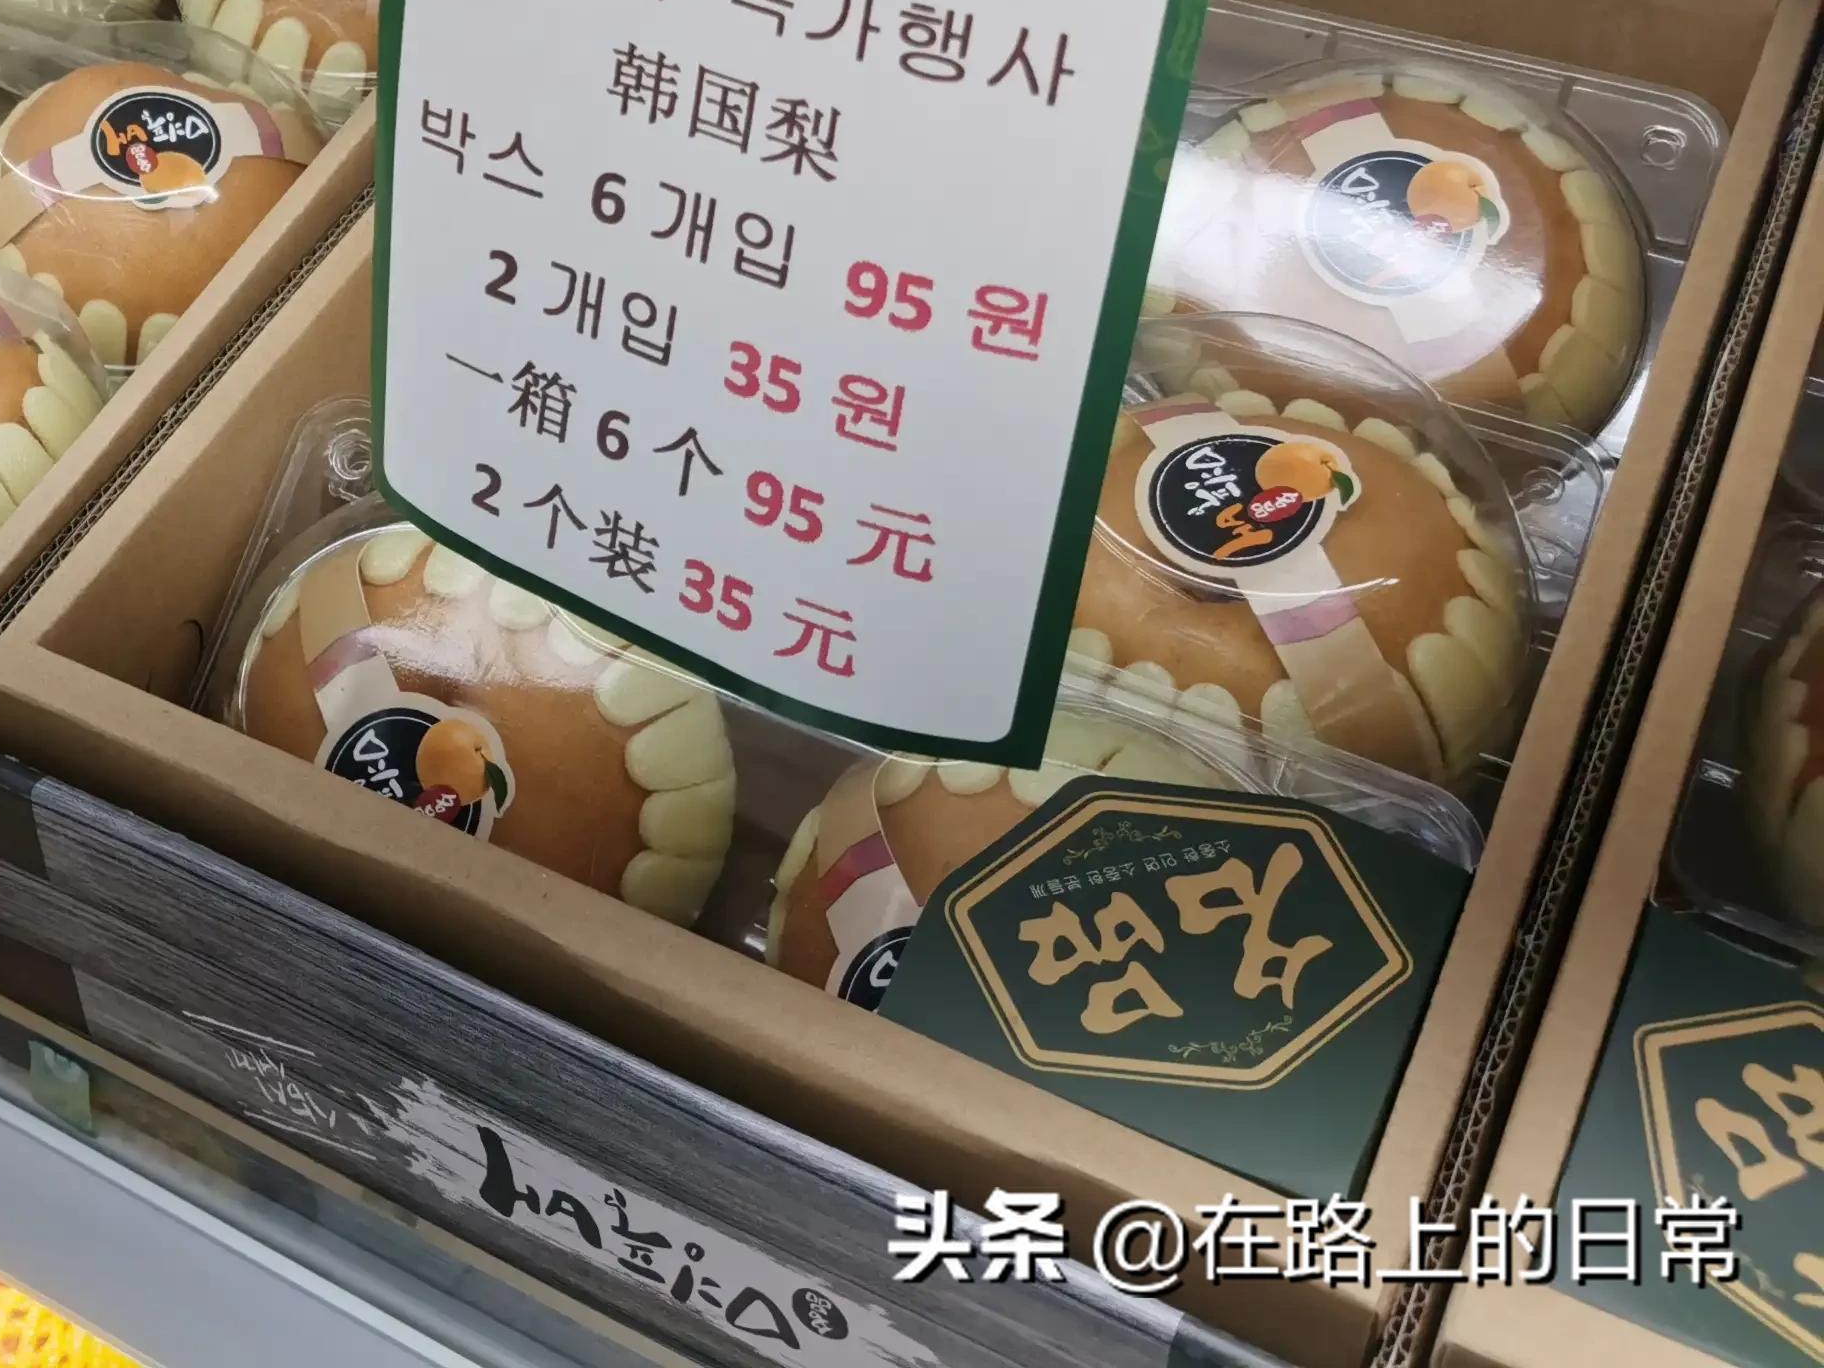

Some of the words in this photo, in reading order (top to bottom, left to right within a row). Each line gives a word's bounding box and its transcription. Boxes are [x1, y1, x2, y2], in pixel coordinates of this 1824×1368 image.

[421, 100, 544, 199] 박스
[607, 43, 840, 182] 韩国梨
